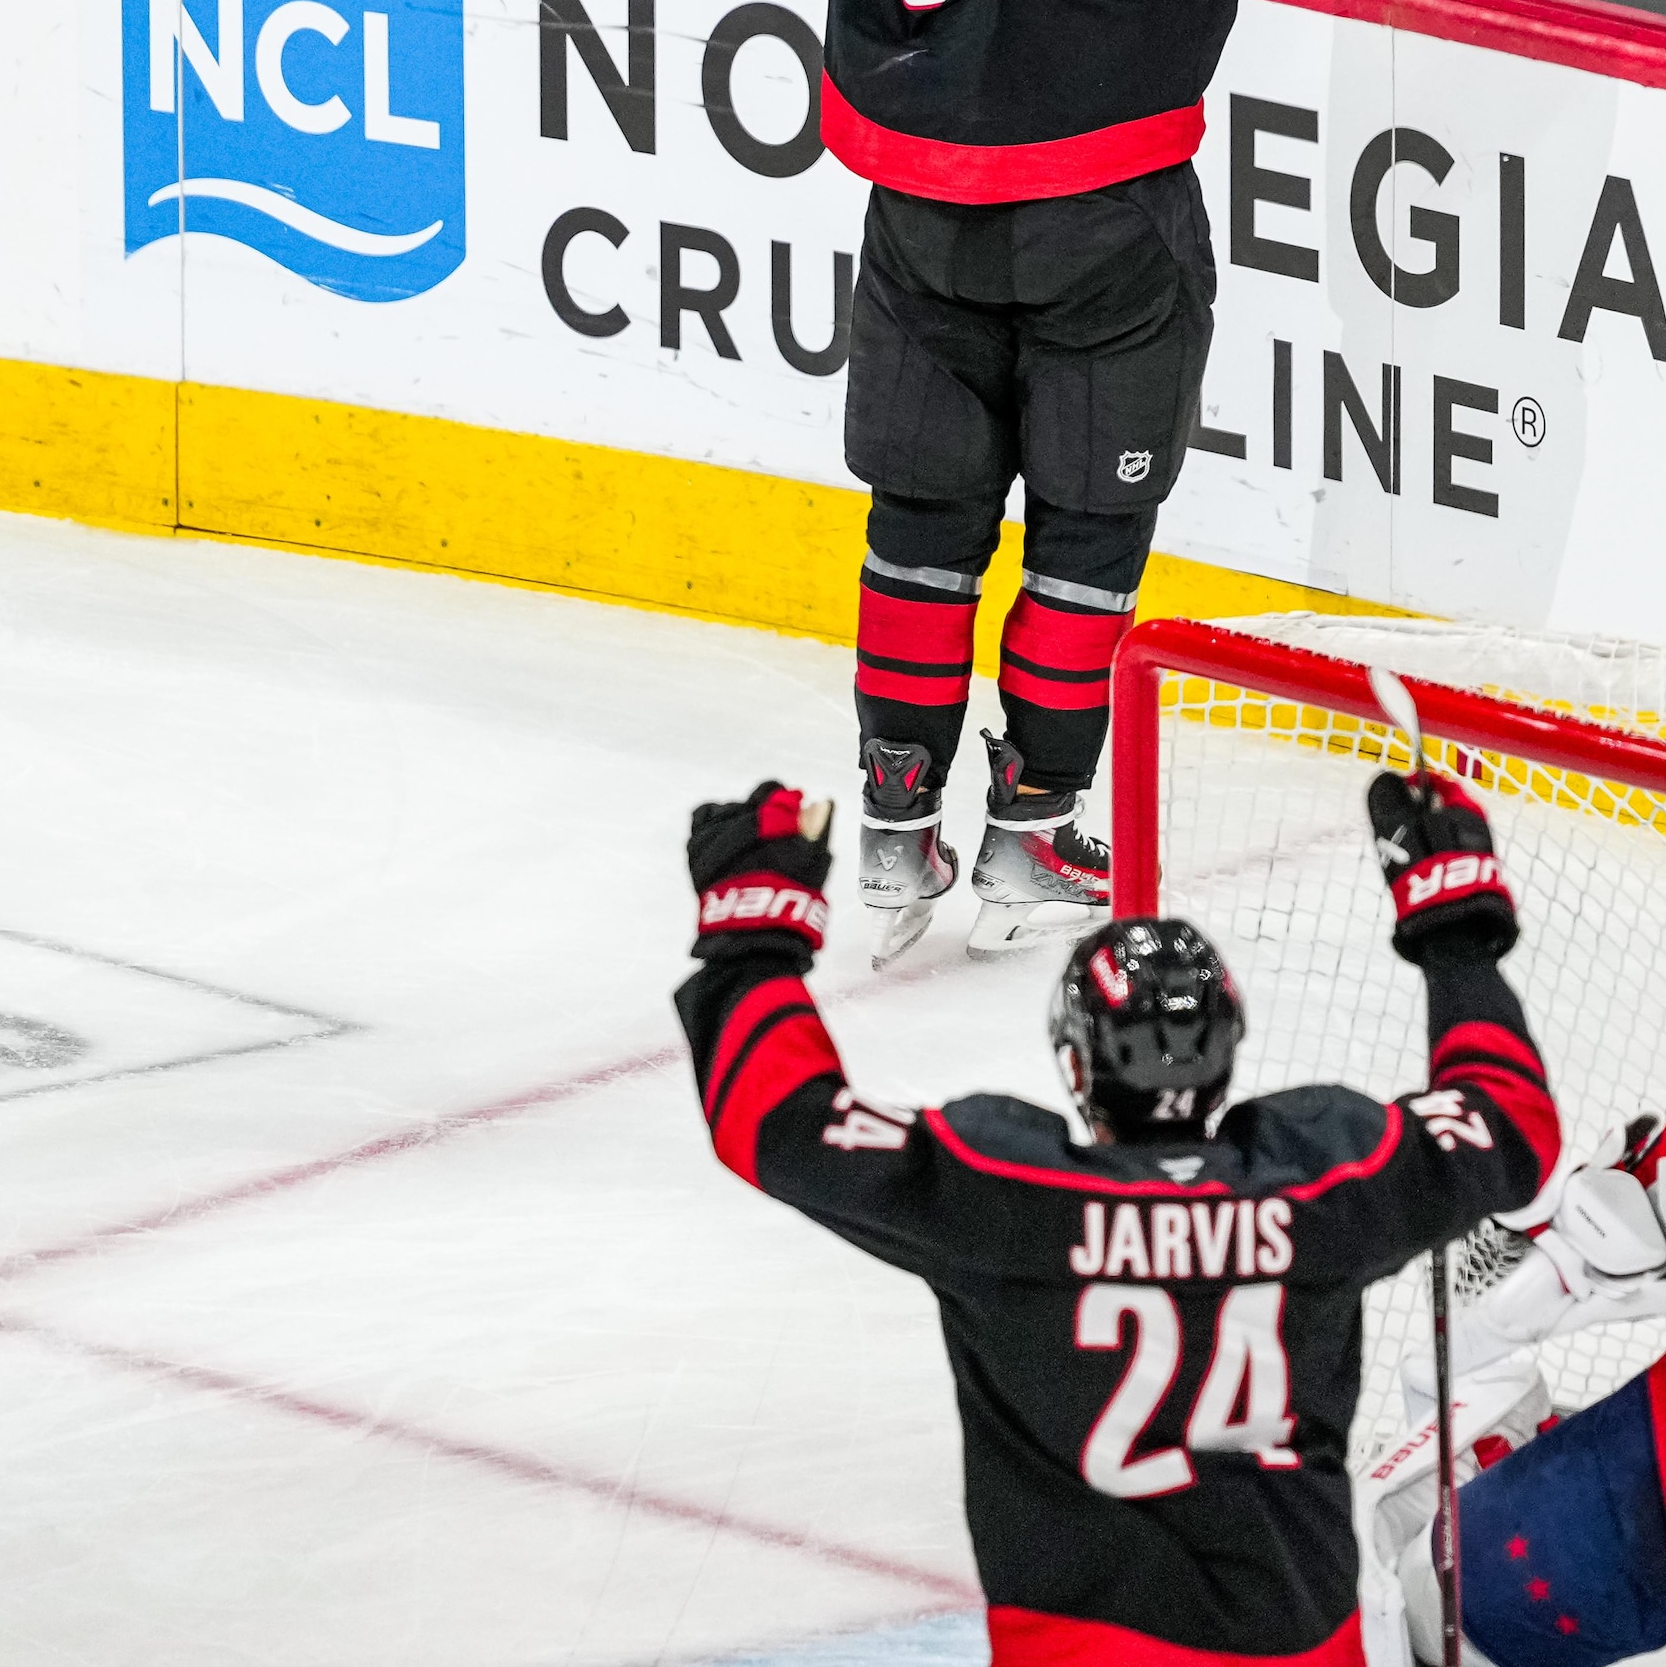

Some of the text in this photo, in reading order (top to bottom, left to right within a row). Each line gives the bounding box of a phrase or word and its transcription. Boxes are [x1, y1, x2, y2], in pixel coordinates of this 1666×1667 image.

[1153, 1089, 1195, 1121] 24
[1069, 1197, 1294, 1279] JARVIS
[1073, 1281, 1303, 1500] 24
